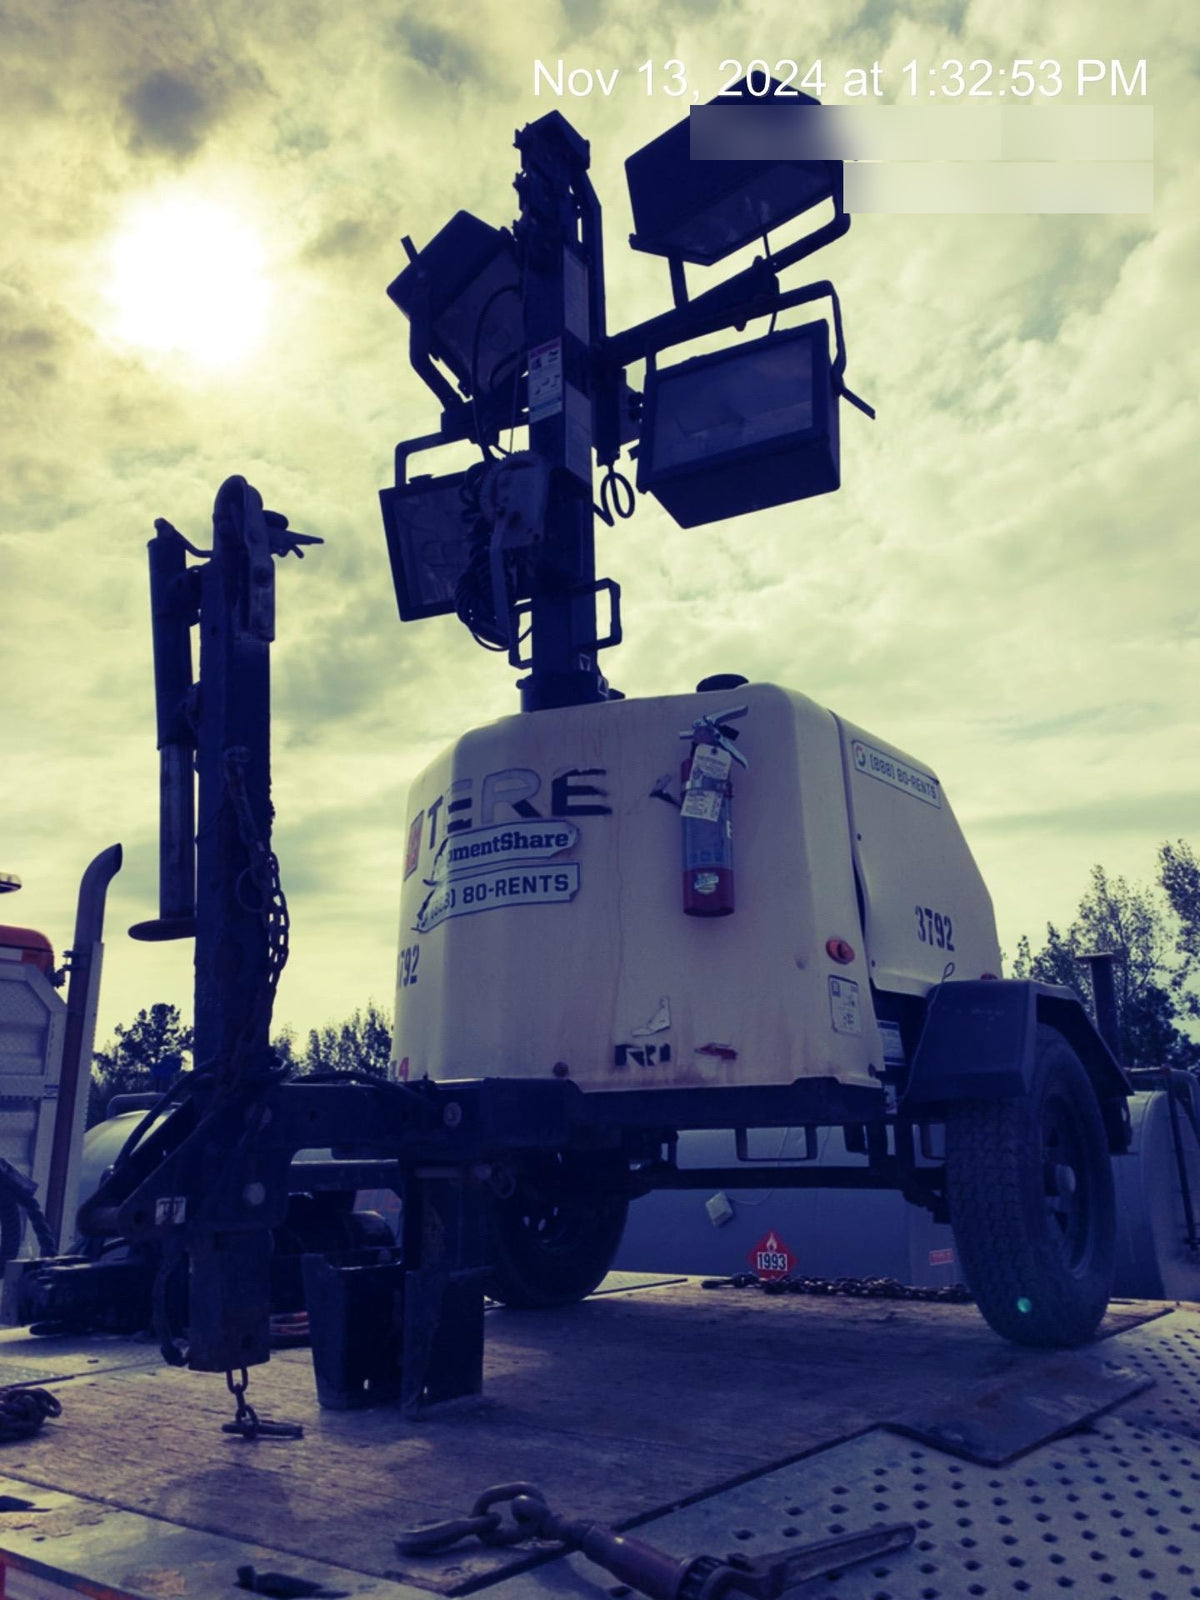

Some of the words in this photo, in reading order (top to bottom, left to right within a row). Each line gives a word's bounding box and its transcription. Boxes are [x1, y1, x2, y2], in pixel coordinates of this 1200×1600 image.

[896, 767, 938, 800] 80-RENTS
[462, 873, 570, 904] 80-RENTS
[914, 905, 956, 952] 3792
[757, 1253, 787, 1270] 1993
